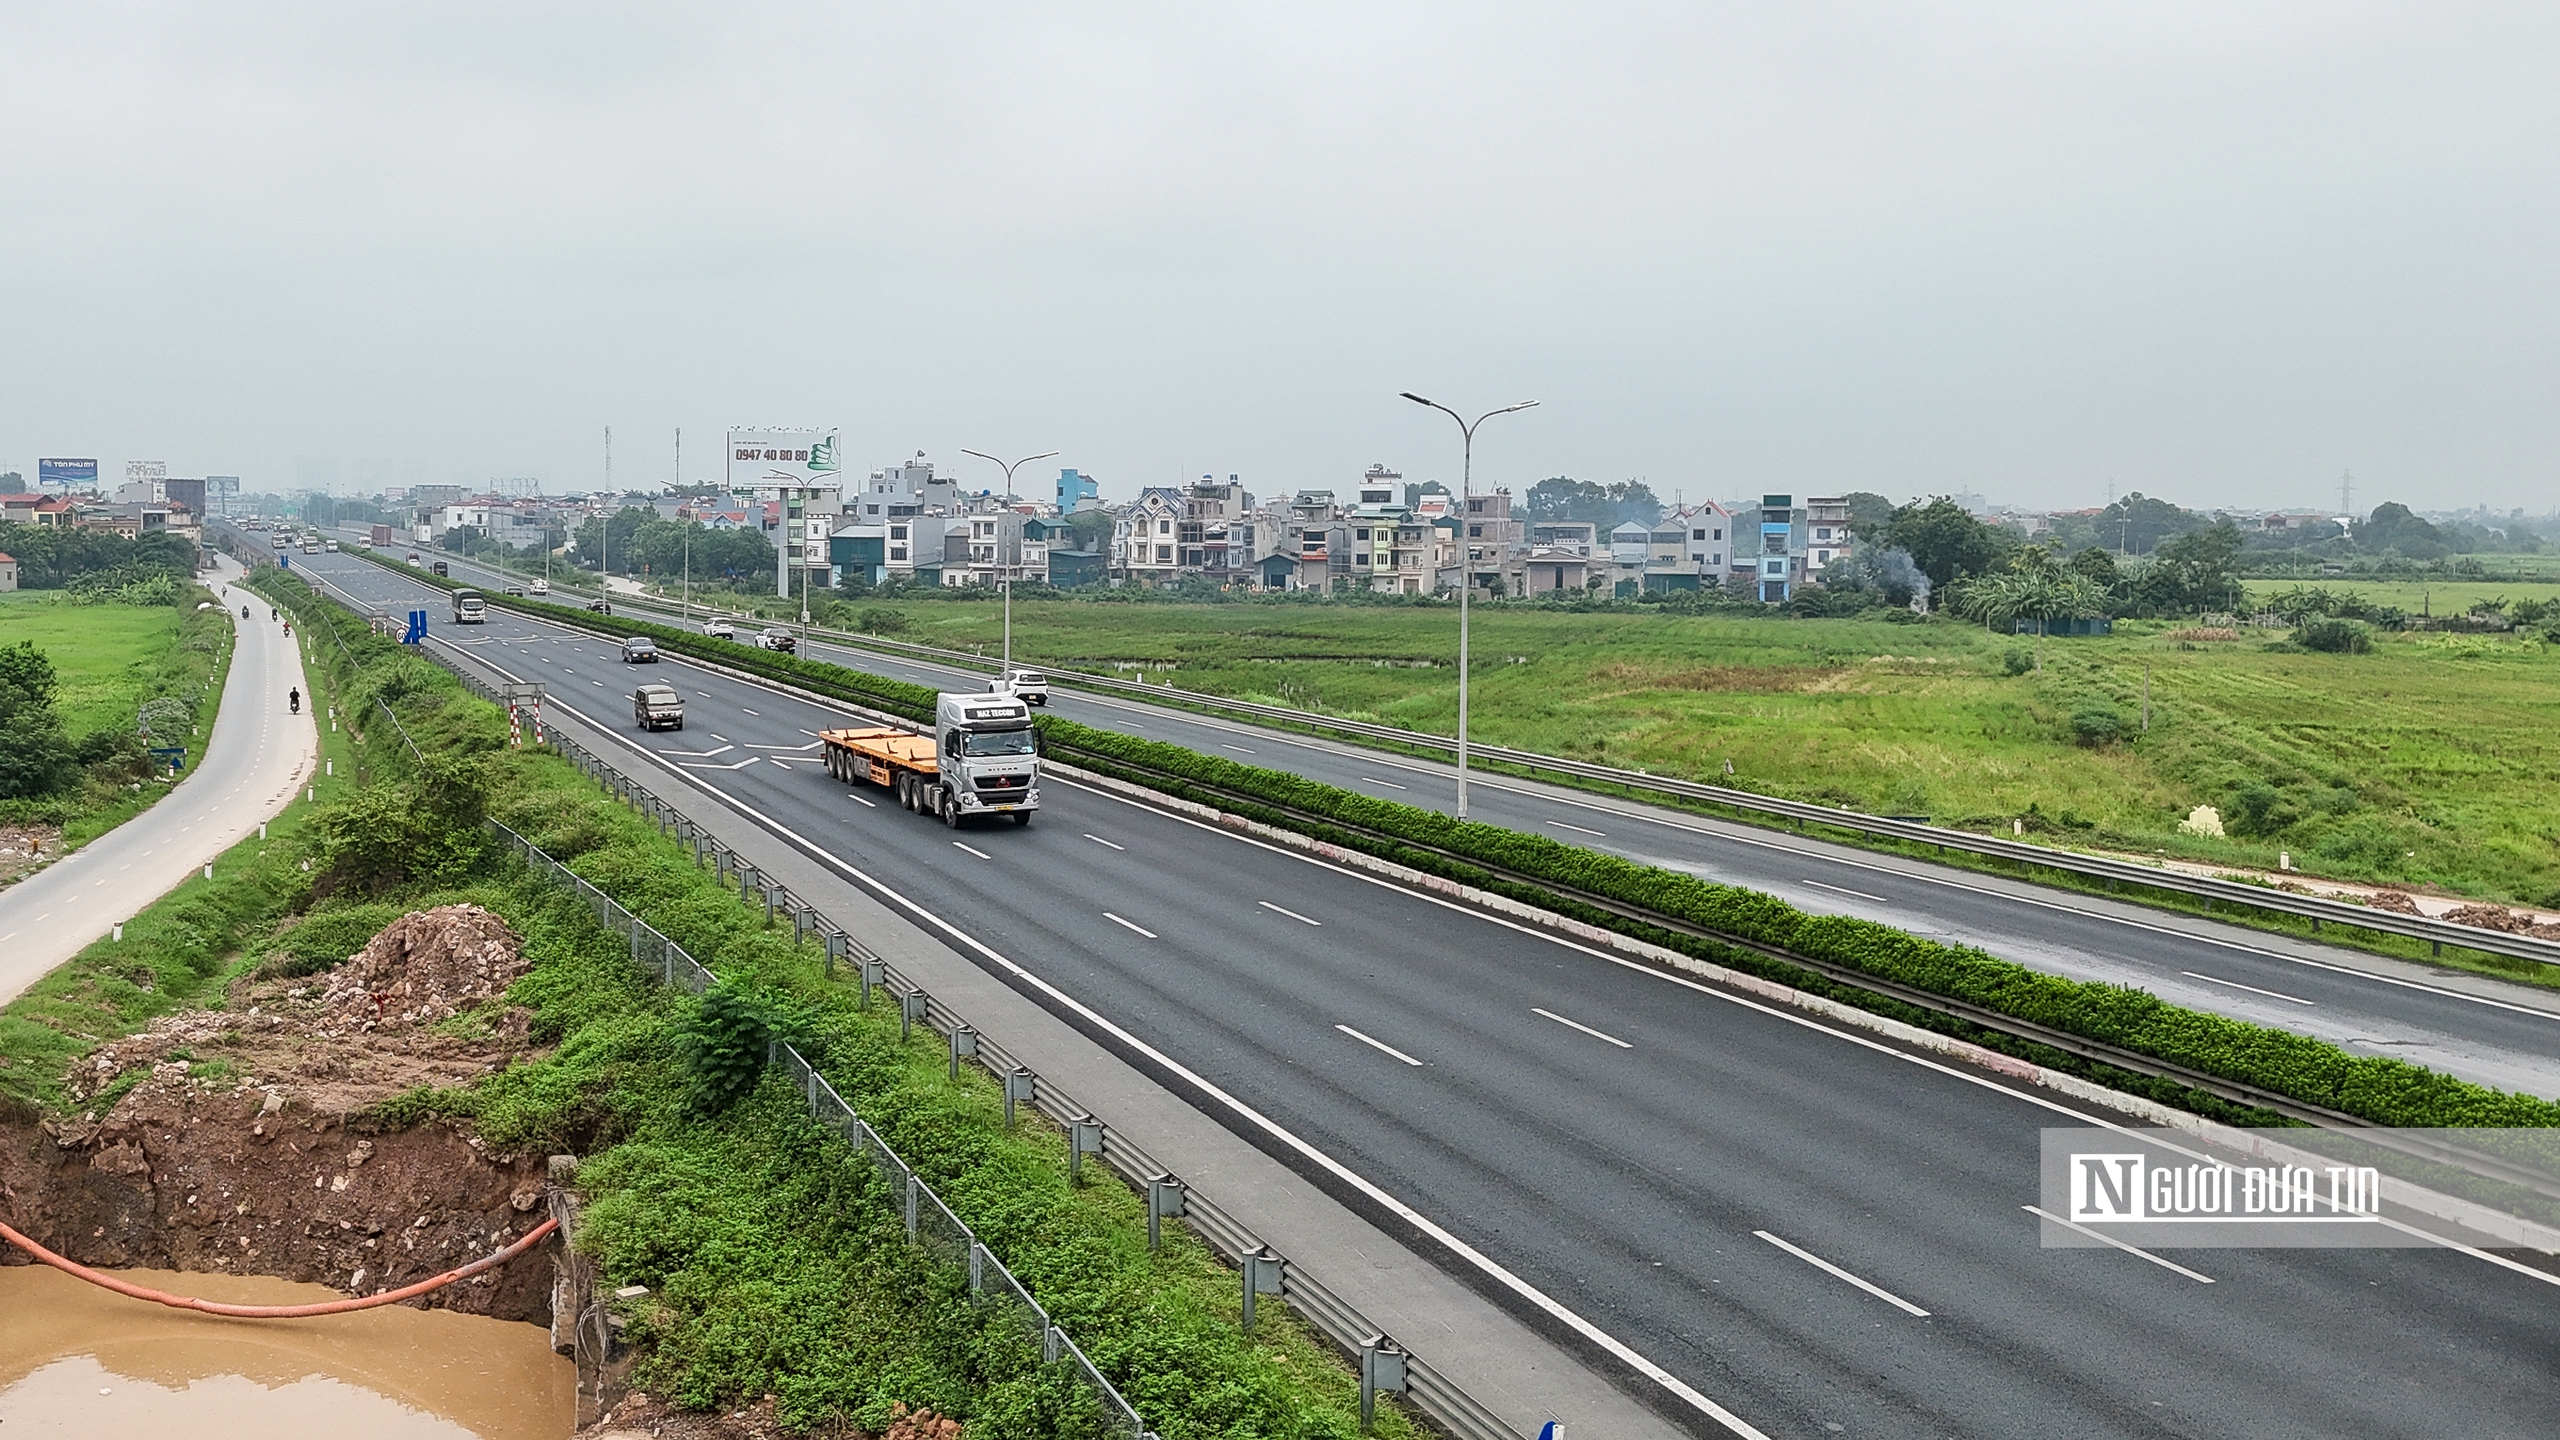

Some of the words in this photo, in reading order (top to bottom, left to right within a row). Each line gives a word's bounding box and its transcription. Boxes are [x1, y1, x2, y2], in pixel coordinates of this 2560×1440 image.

[736, 449, 761, 460] 0947
[763, 449, 777, 460] 40
[779, 450, 792, 461] 80
[795, 450, 808, 461] 80
